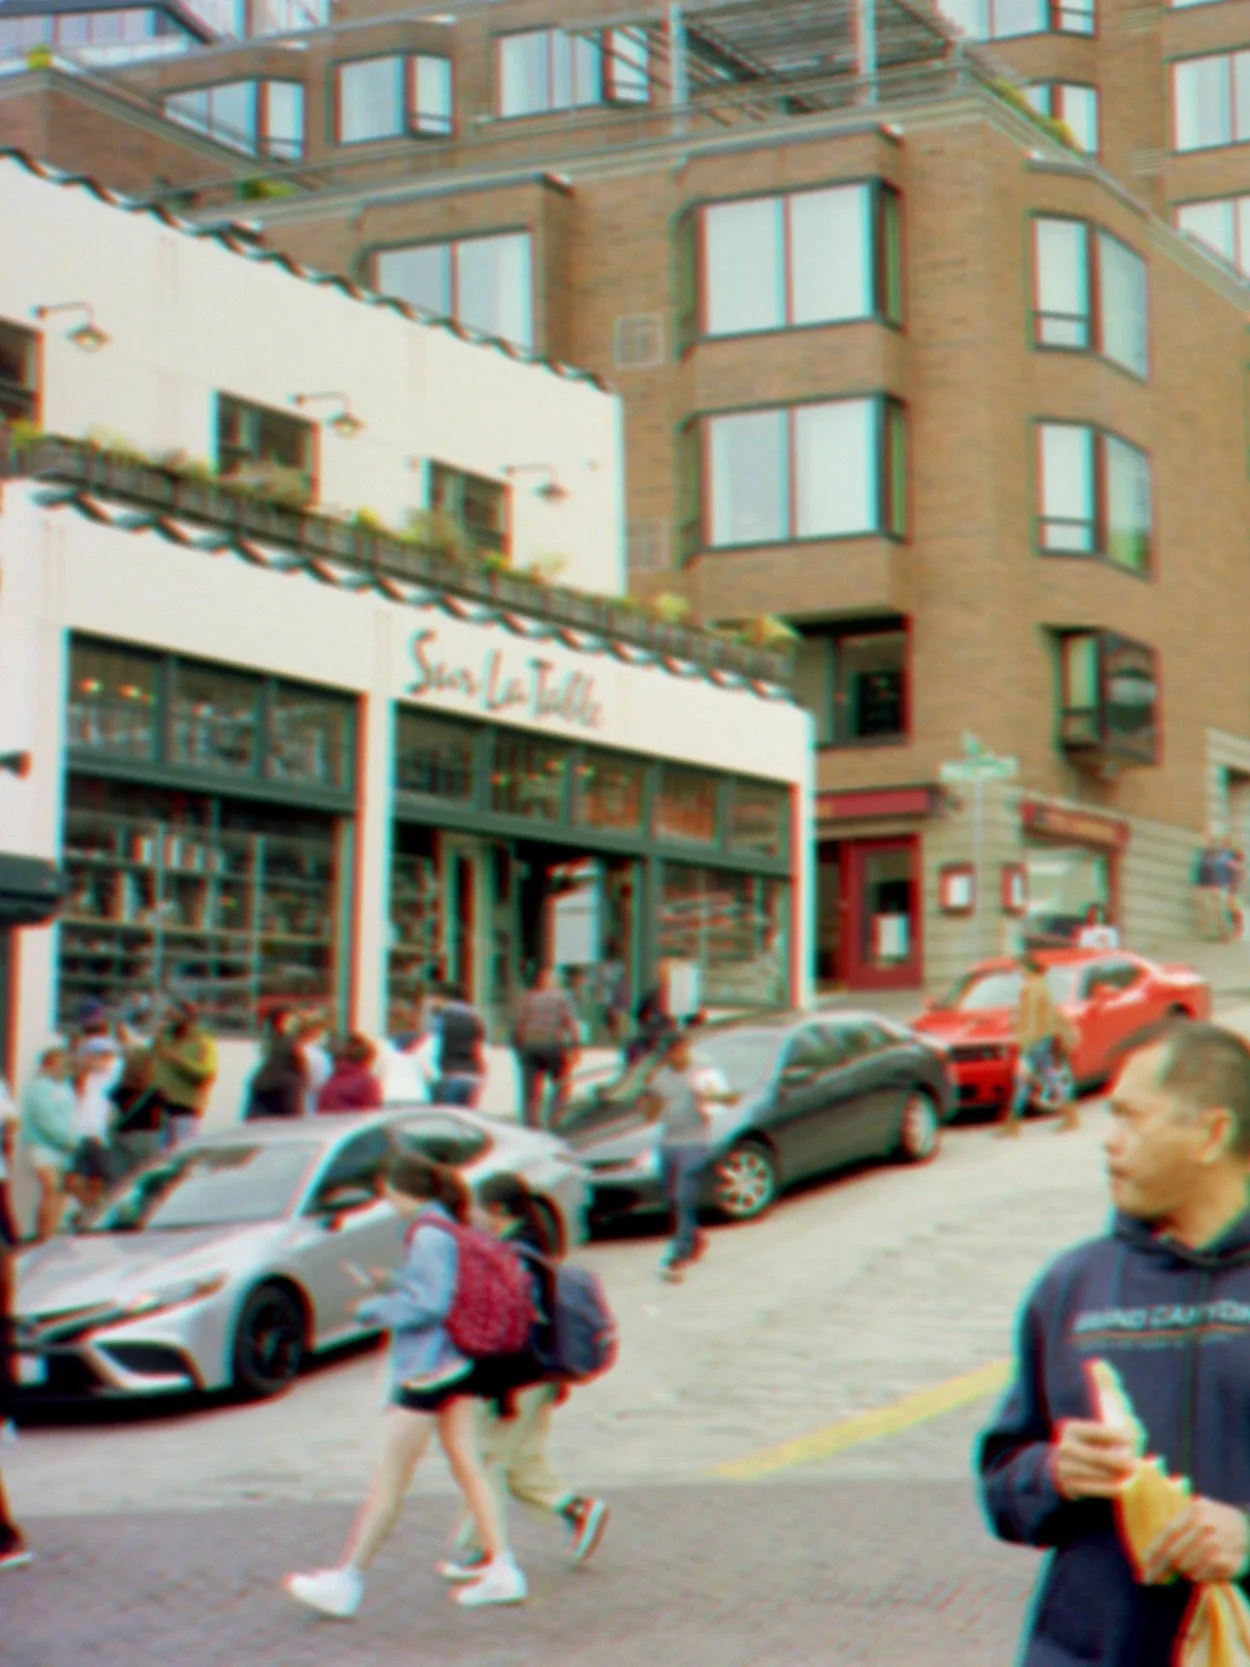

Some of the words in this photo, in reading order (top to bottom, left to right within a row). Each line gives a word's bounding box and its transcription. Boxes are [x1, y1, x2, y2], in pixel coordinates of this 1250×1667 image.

[406, 628, 479, 697] Sur
[483, 648, 528, 712] La
[529, 656, 605, 728] Table
